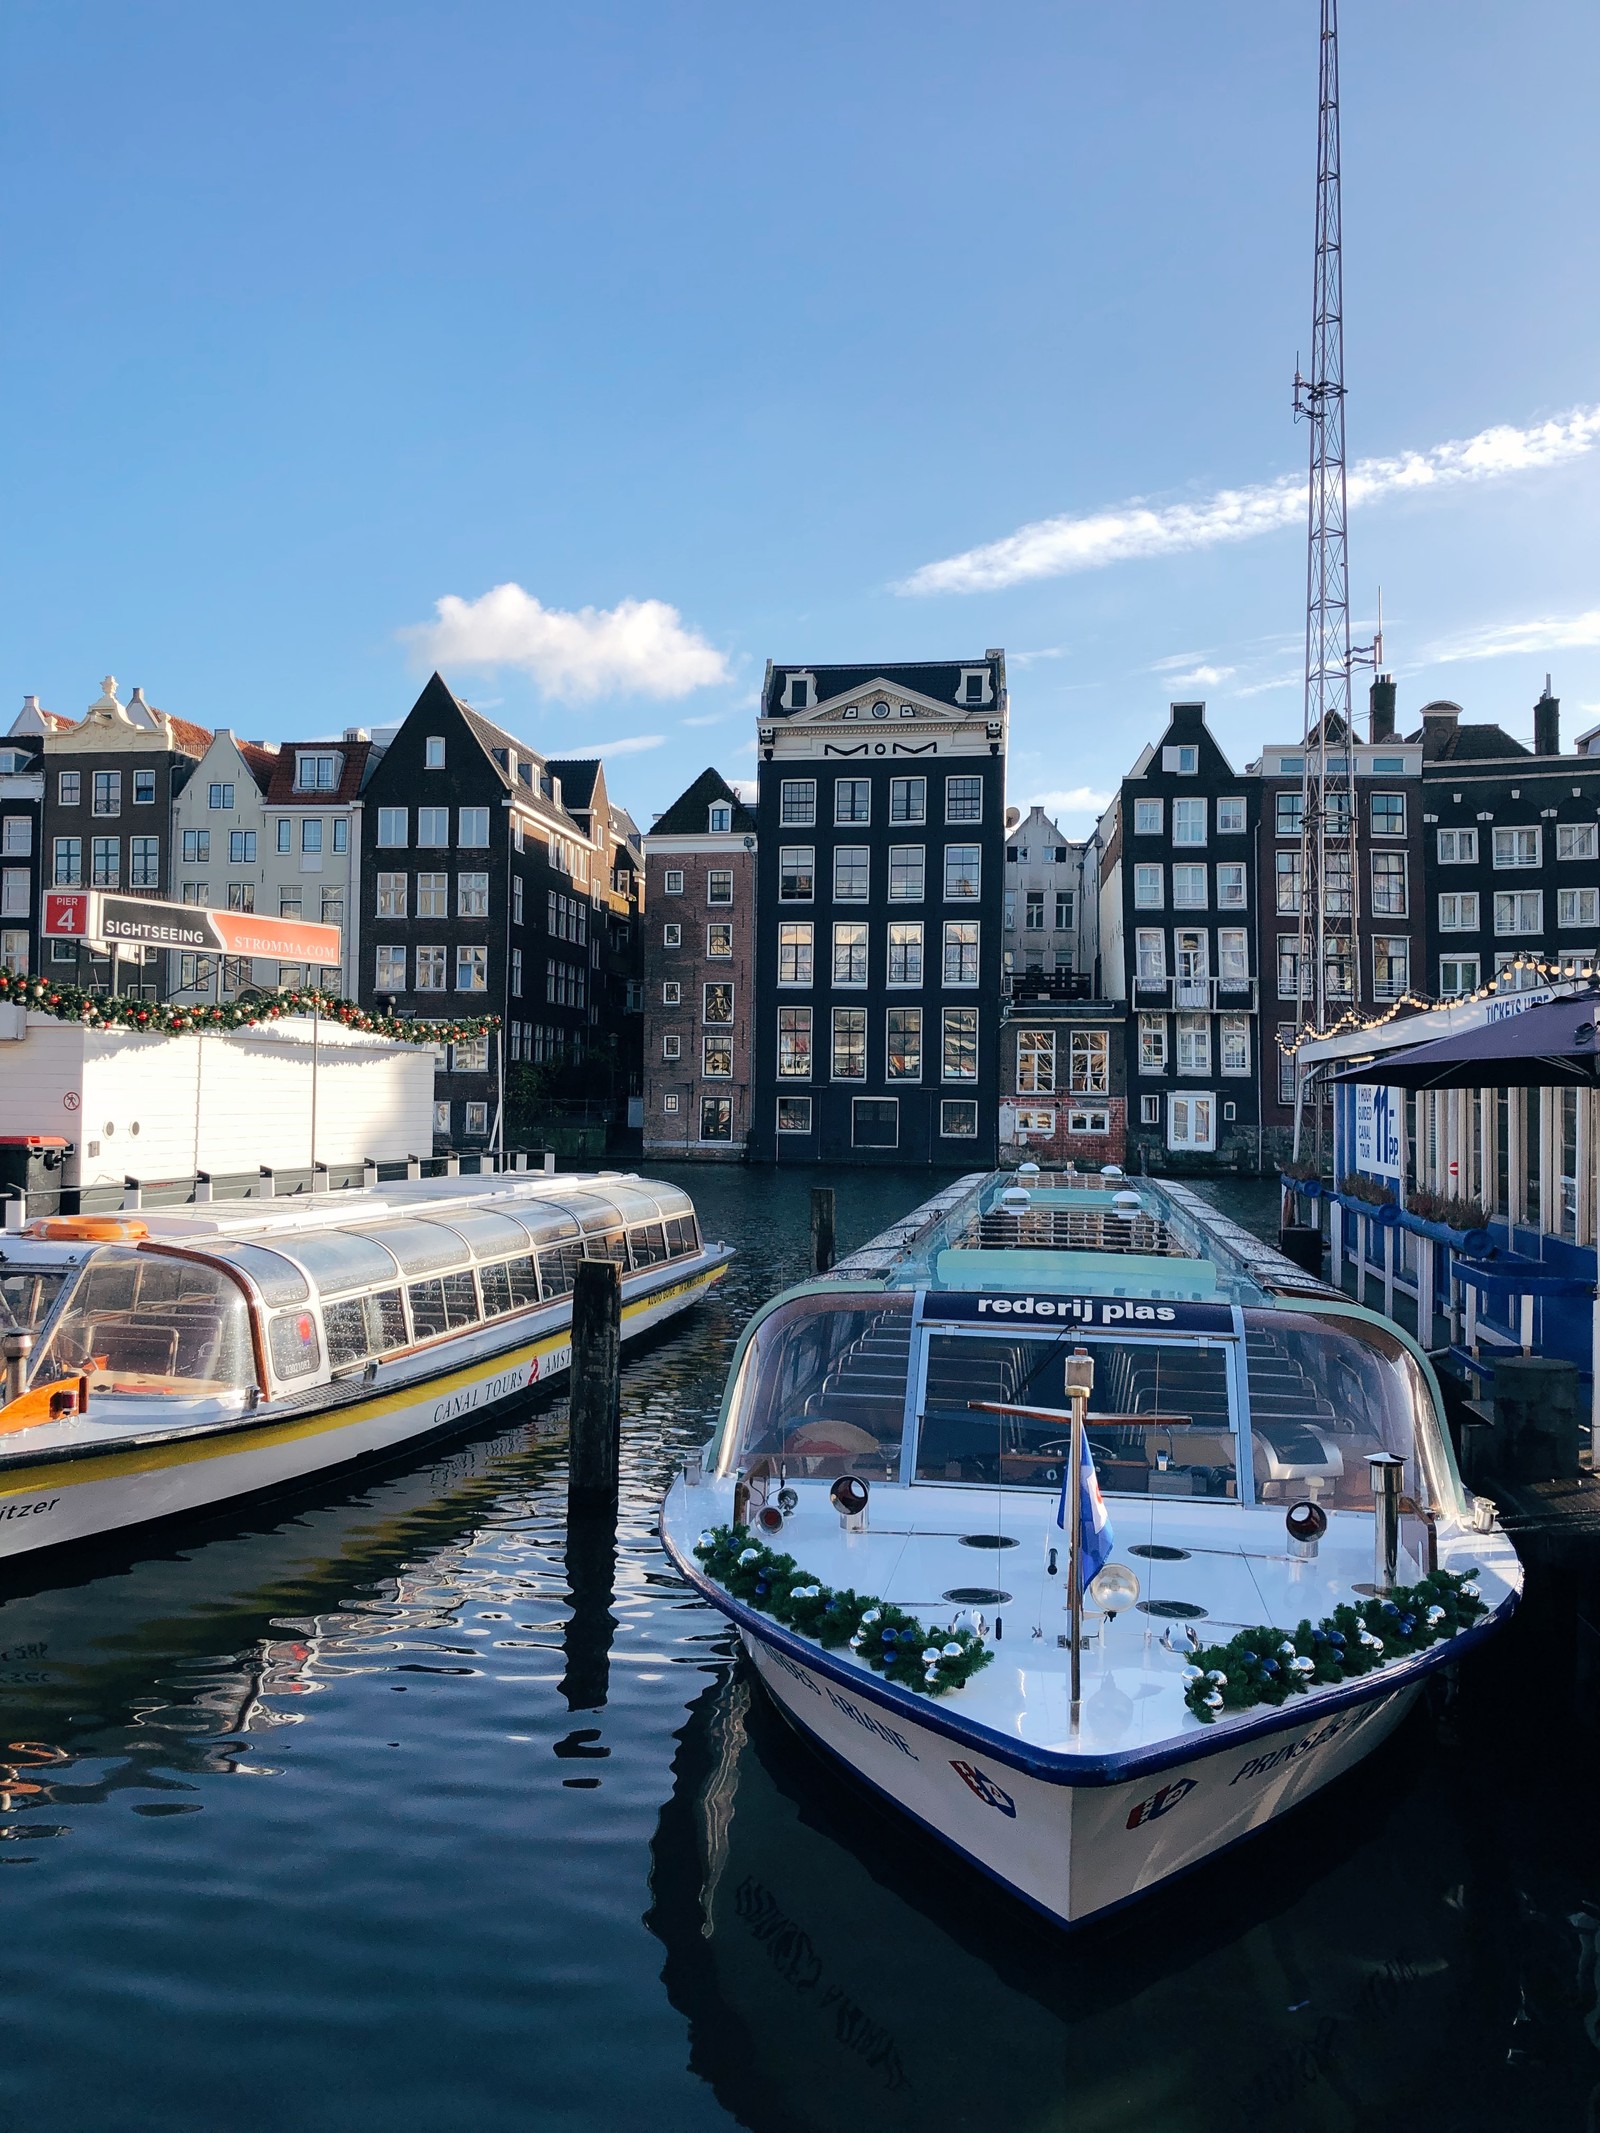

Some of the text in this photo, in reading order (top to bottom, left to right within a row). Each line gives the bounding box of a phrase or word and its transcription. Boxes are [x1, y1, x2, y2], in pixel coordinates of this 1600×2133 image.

[56, 898, 78, 906] PIER
[57, 908, 75, 932] 4
[106, 920, 204, 943] SIGHTSEEING
[234, 935, 335, 958] STROMMA.COM
[1358, 1106, 1372, 1120] GUIDED
[1359, 1125, 1371, 1140] CANAL
[1360, 1143, 1370, 1158] TOUR
[978, 1297, 1176, 1324] rederij plas
[433, 1389, 479, 1423] CANAL
[485, 1368, 523, 1401] TOURS
[825, 1686, 920, 1762] ARIANE
